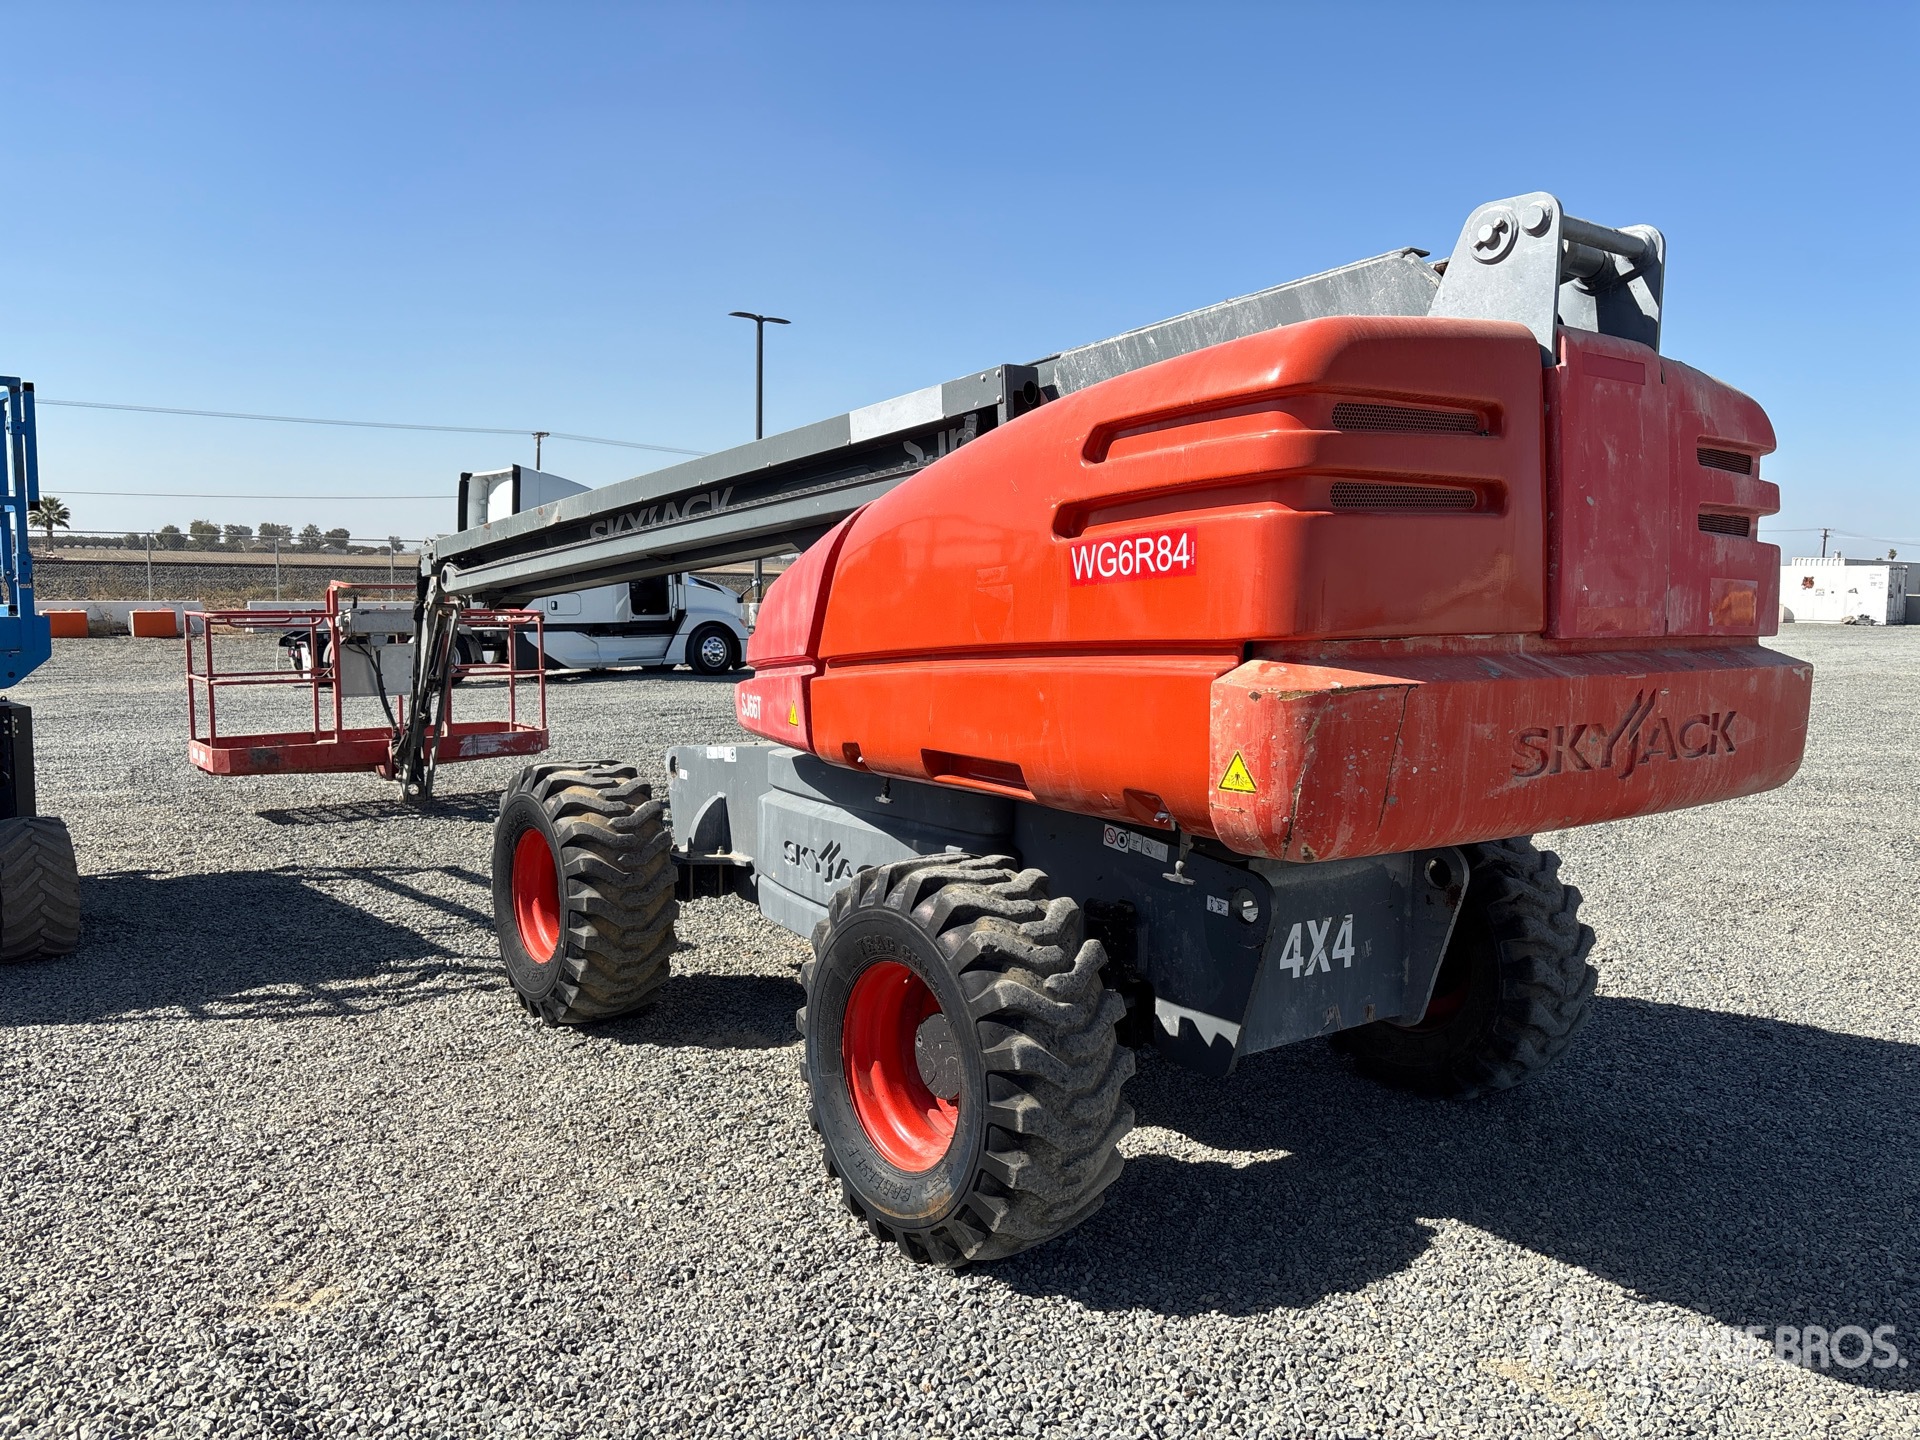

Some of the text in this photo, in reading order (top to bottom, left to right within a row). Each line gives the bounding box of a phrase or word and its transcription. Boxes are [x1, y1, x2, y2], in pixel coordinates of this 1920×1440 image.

[1071, 532, 1190, 580] WG6R84
[1511, 688, 1738, 780] SKYJACK
[783, 840, 875, 884] SKYJA
[1279, 913, 1356, 979] 4X4
